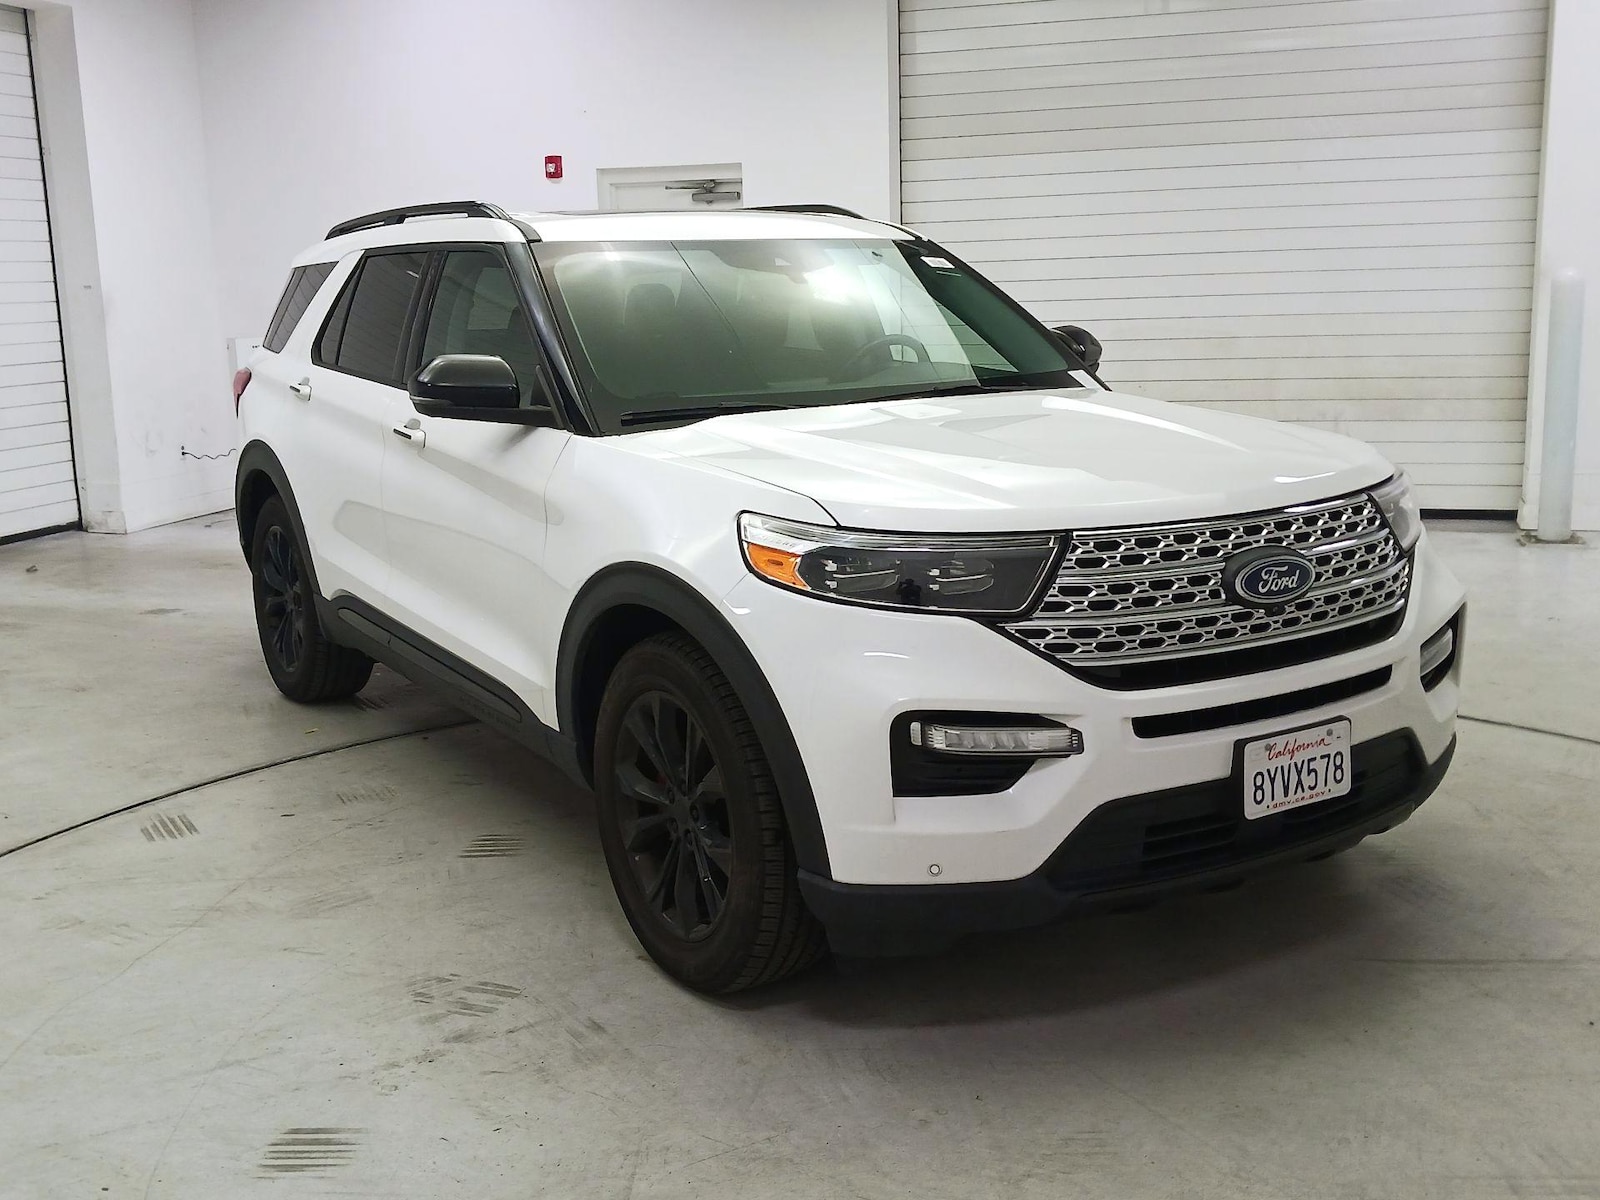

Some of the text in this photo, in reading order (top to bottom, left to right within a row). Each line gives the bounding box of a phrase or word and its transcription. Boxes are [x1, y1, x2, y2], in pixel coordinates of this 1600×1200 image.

[1258, 565, 1300, 593] Ford
[1267, 738, 1331, 761] California
[1253, 751, 1344, 805] 8YVX578
